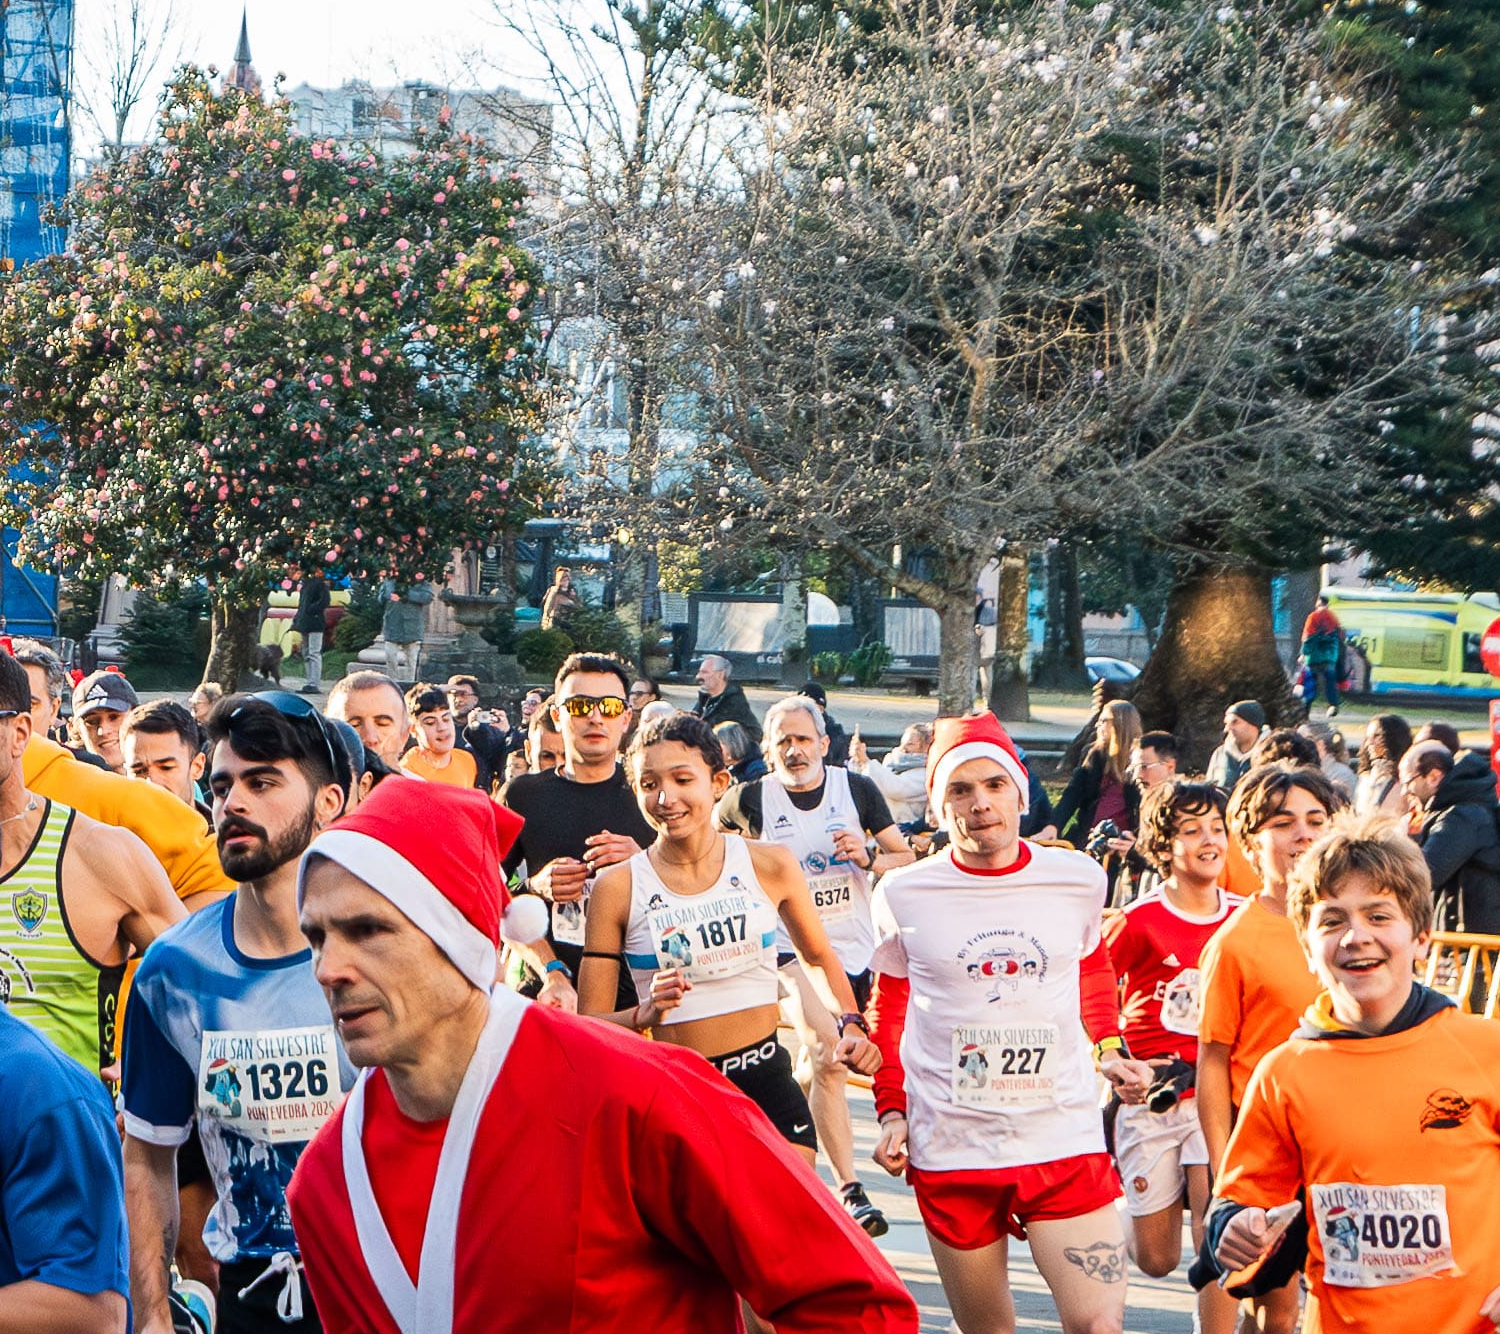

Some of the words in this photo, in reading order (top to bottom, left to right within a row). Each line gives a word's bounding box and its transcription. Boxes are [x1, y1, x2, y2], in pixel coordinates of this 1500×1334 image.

[675, 905, 697, 924] SAN
[697, 896, 749, 920] SILVESTRE
[814, 886, 851, 908] 6374
[696, 913, 747, 949] 1817
[230, 1037, 253, 1060] SAN
[256, 1033, 328, 1060] SILVESTRE
[979, 1028, 1001, 1045] SAN
[1003, 1027, 1055, 1045] SILVESTRE
[721, 1041, 777, 1076] PRO
[1001, 1047, 1047, 1075] 227
[245, 1058, 329, 1101] 1326
[246, 1102, 310, 1122] PONTEVEDRA
[311, 1100, 336, 1117] 2025
[1345, 1187, 1369, 1209] SAN
[1372, 1188, 1441, 1211] SILVESTRE
[1361, 1213, 1442, 1249] 4020
[1361, 1251, 1423, 1269] PONTEVEDRA
